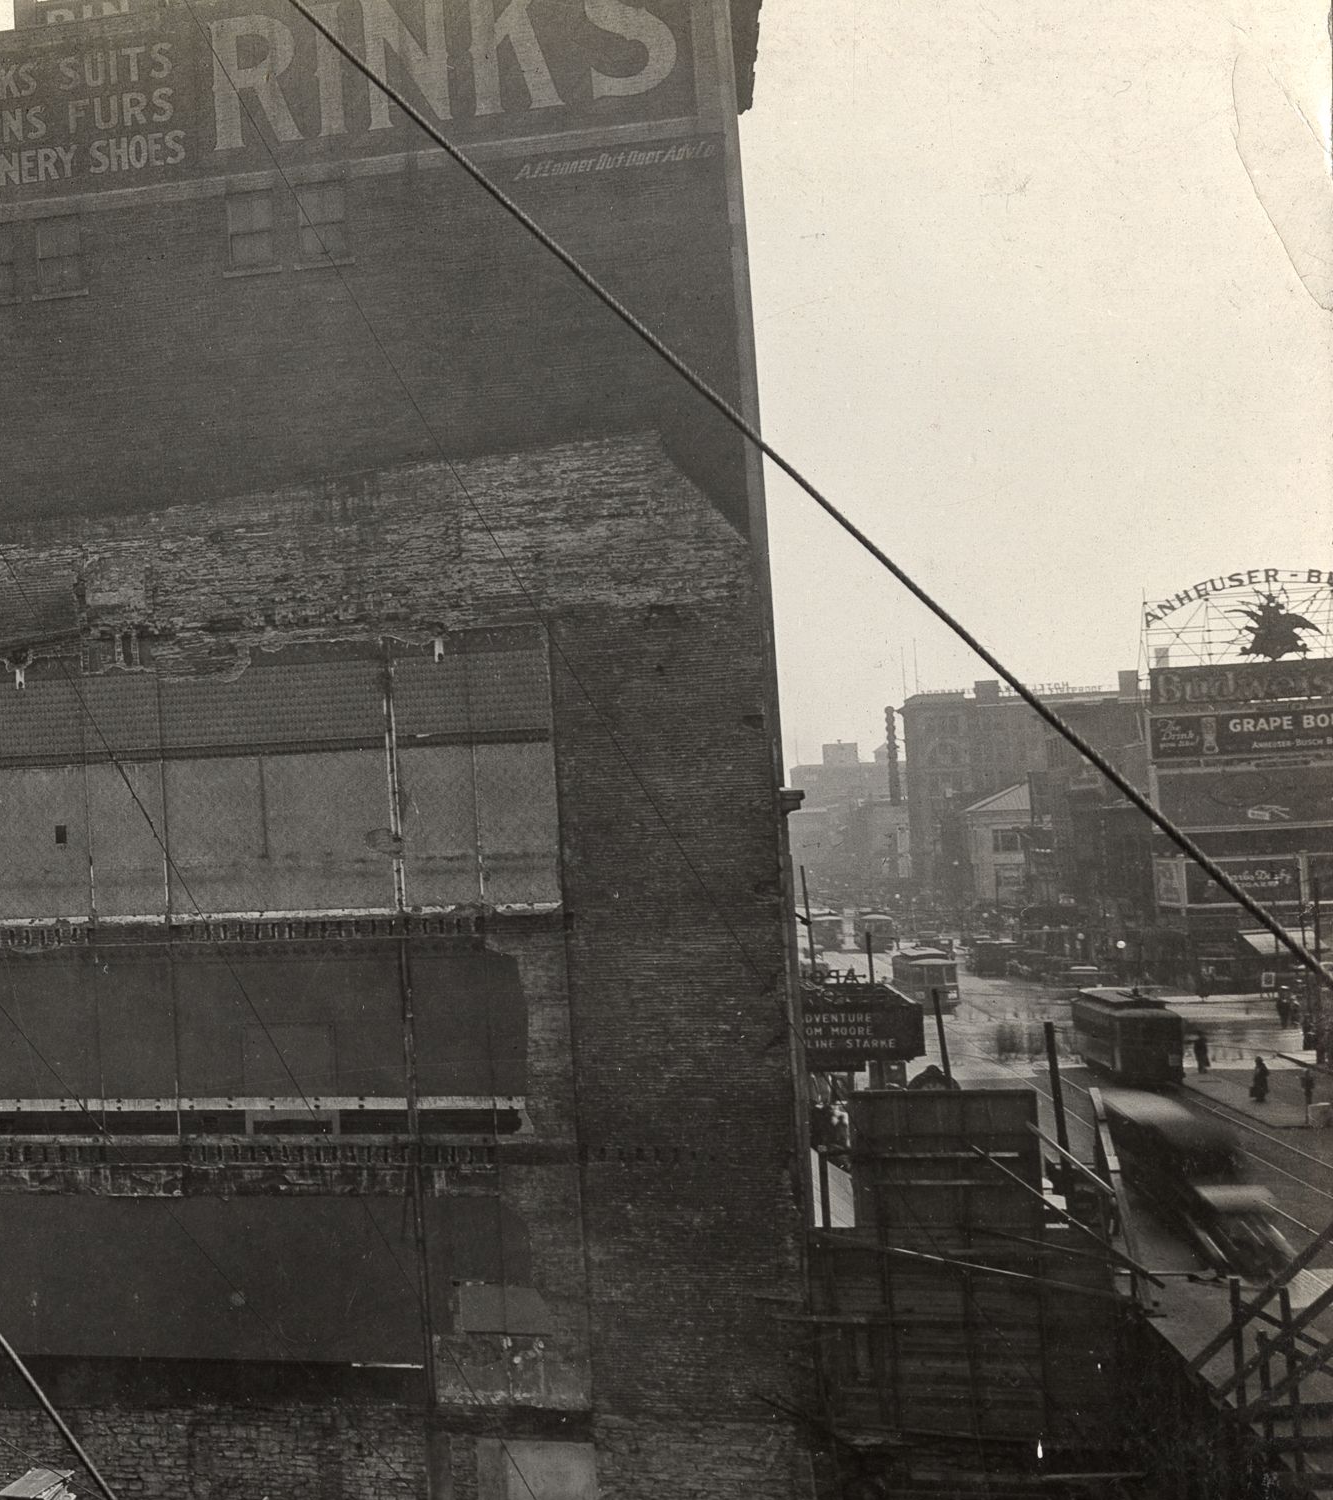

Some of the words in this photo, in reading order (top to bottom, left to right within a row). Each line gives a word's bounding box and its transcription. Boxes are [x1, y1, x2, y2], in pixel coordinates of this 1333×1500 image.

[58, 42, 173, 91] SUITS
[209, 0, 678, 151] RINKS
[68, 86, 175, 134] FURS
[88, 129, 186, 174] SHOES
[1143, 567, 1333, 628] ANHEUSER-B
[1229, 715, 1294, 732] GRAPE
[1302, 713, 1333, 729] BO
[804, 1013, 873, 1024] DVENTURE
[805, 1026, 823, 1037] OM
[831, 1026, 874, 1037] MOORE
[803, 1039, 837, 1050] LINE
[846, 1039, 897, 1049] STARKE
